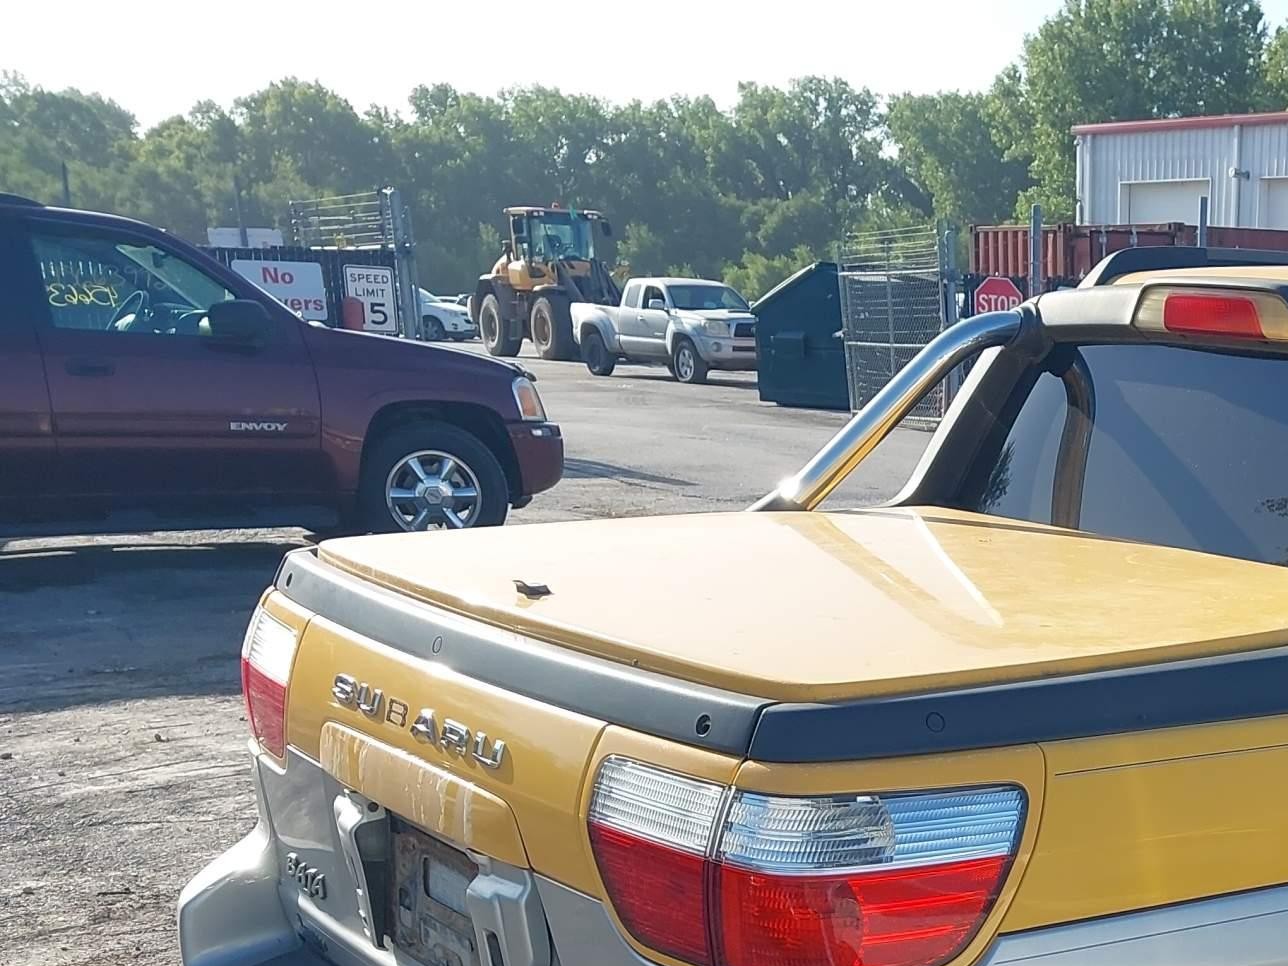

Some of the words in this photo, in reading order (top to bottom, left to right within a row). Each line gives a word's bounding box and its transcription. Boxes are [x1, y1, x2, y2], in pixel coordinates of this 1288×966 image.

[262, 267, 294, 284] No
[350, 273, 389, 284] SPEED
[355, 287, 385, 298] LIMIT
[979, 293, 1019, 312] STOP
[230, 422, 288, 431] ENVOY
[333, 673, 505, 769] SUBARU
[287, 851, 326, 899] BAJA
